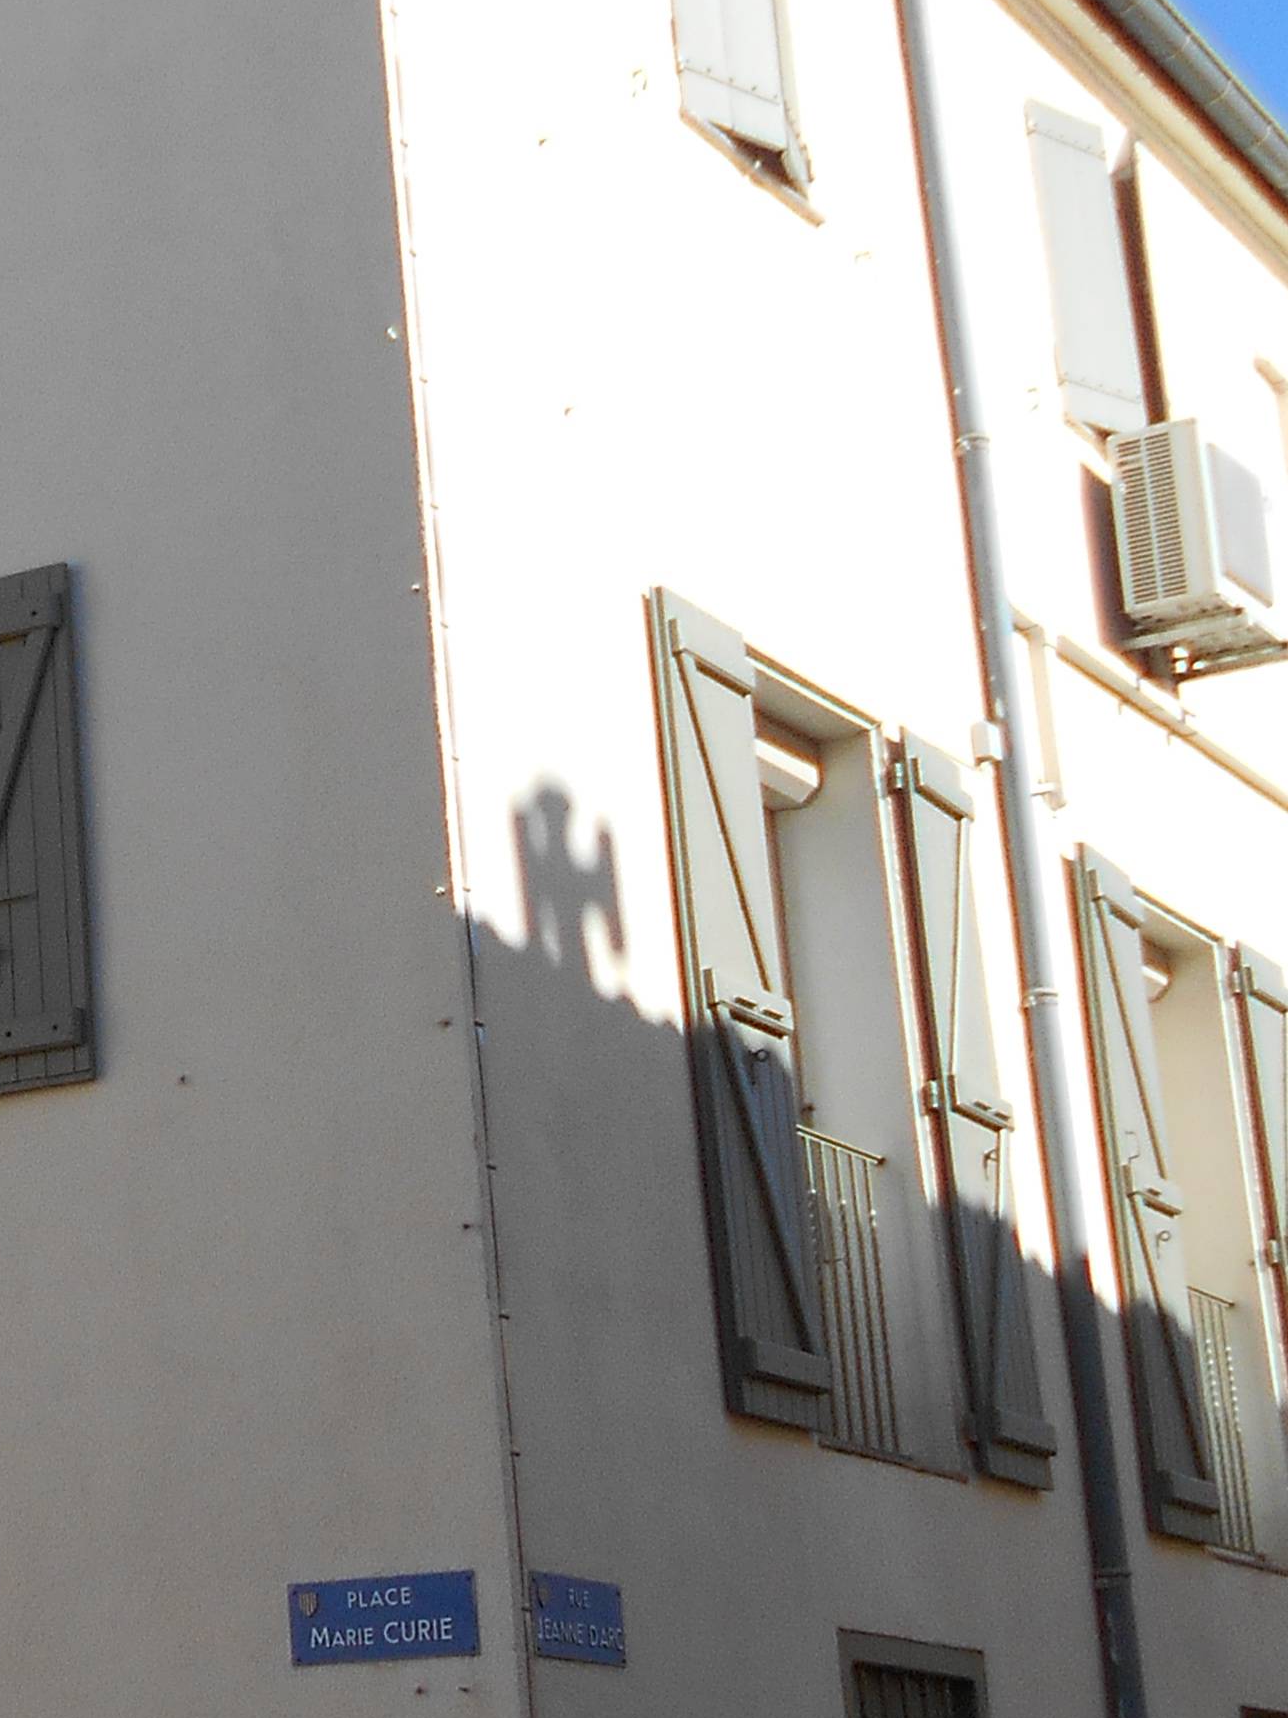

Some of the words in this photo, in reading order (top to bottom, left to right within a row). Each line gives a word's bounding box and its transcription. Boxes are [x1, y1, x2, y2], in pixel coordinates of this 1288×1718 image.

[347, 1586, 411, 1608] PLACE
[568, 1588, 591, 1608] RUE
[310, 1627, 374, 1648] MARIE
[383, 1617, 452, 1643] CURIE
[538, 1616, 585, 1644] JEANNE
